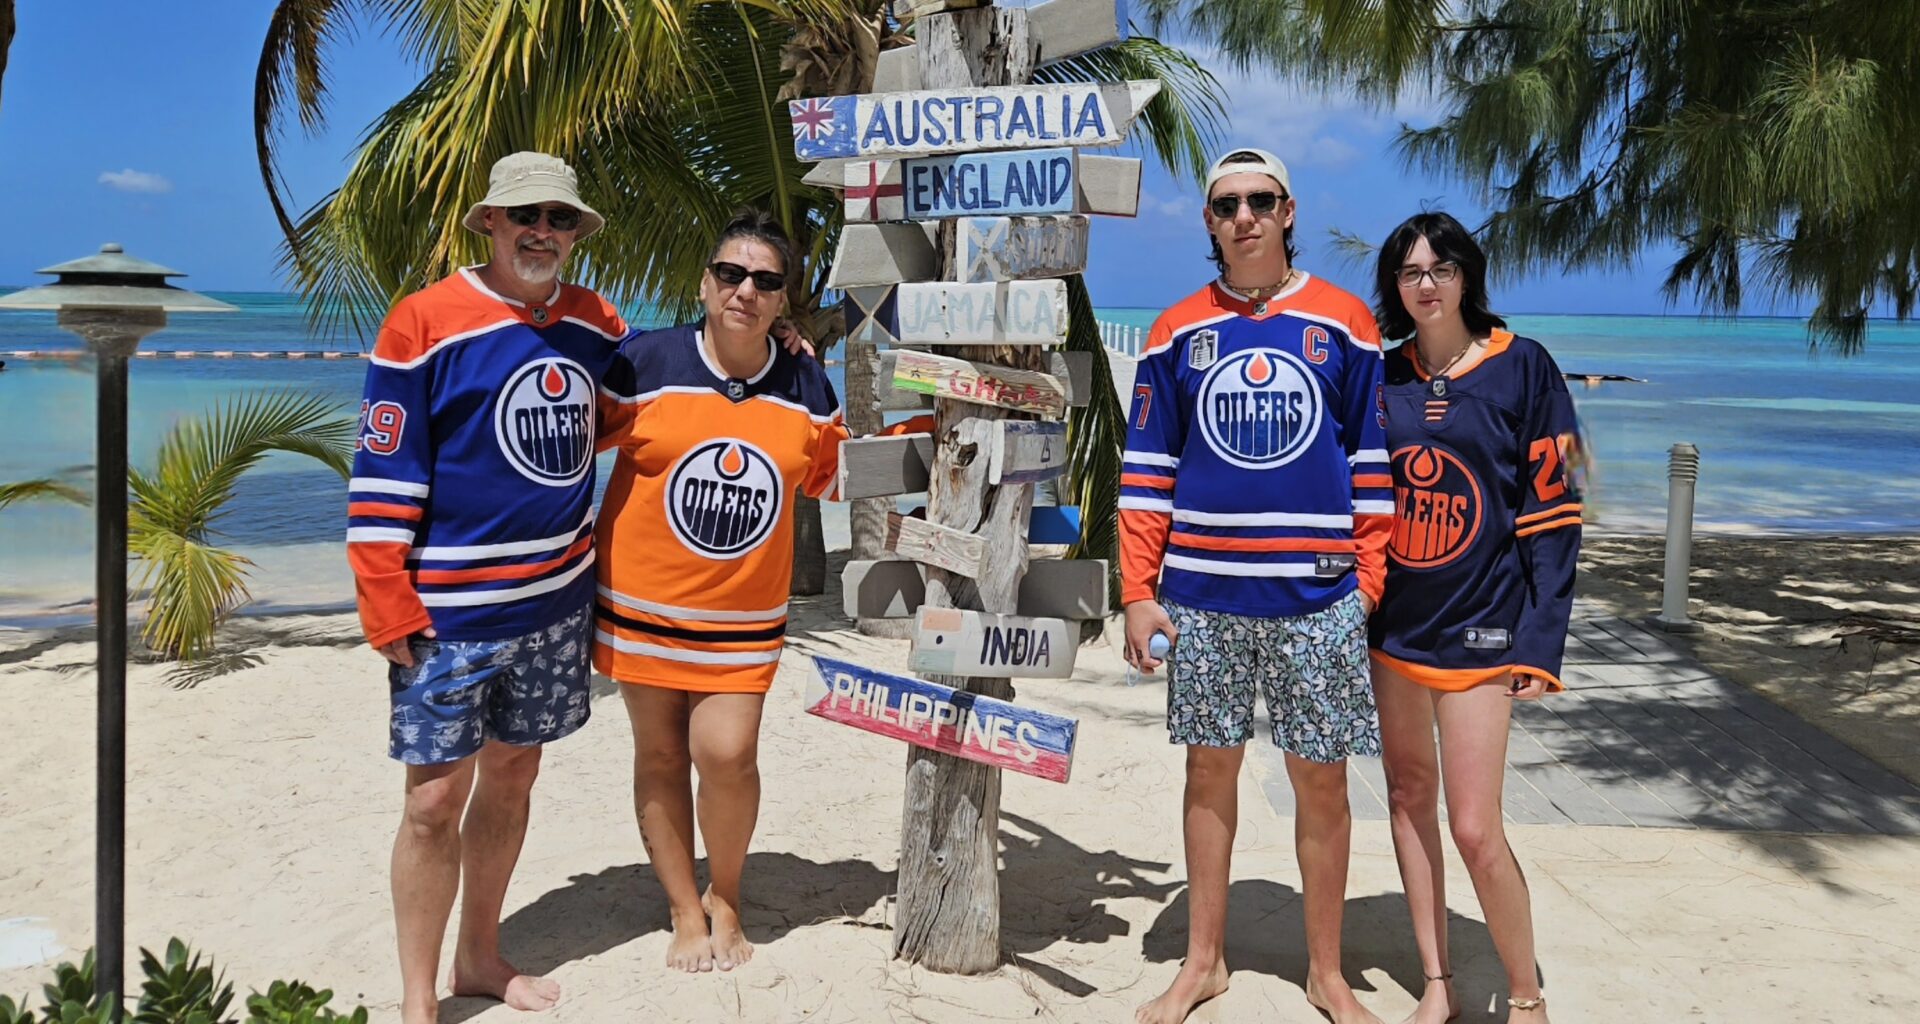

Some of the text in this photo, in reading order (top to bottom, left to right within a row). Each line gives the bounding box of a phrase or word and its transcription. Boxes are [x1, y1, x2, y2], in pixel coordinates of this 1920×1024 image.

[861, 92, 1106, 148] AUSTRALIA
[912, 157, 1071, 212] ENGLAND
[902, 288, 1057, 334] JAMAICA
[1303, 325, 1328, 364] C
[949, 369, 1063, 411] GHA
[515, 403, 589, 474] OILERS
[1214, 391, 1303, 458] OILERS
[682, 477, 768, 548] OILERS
[1390, 486, 1468, 561] ILERS
[980, 626, 1050, 668] INDIA
[829, 673, 1039, 764] PHILIPPINES
